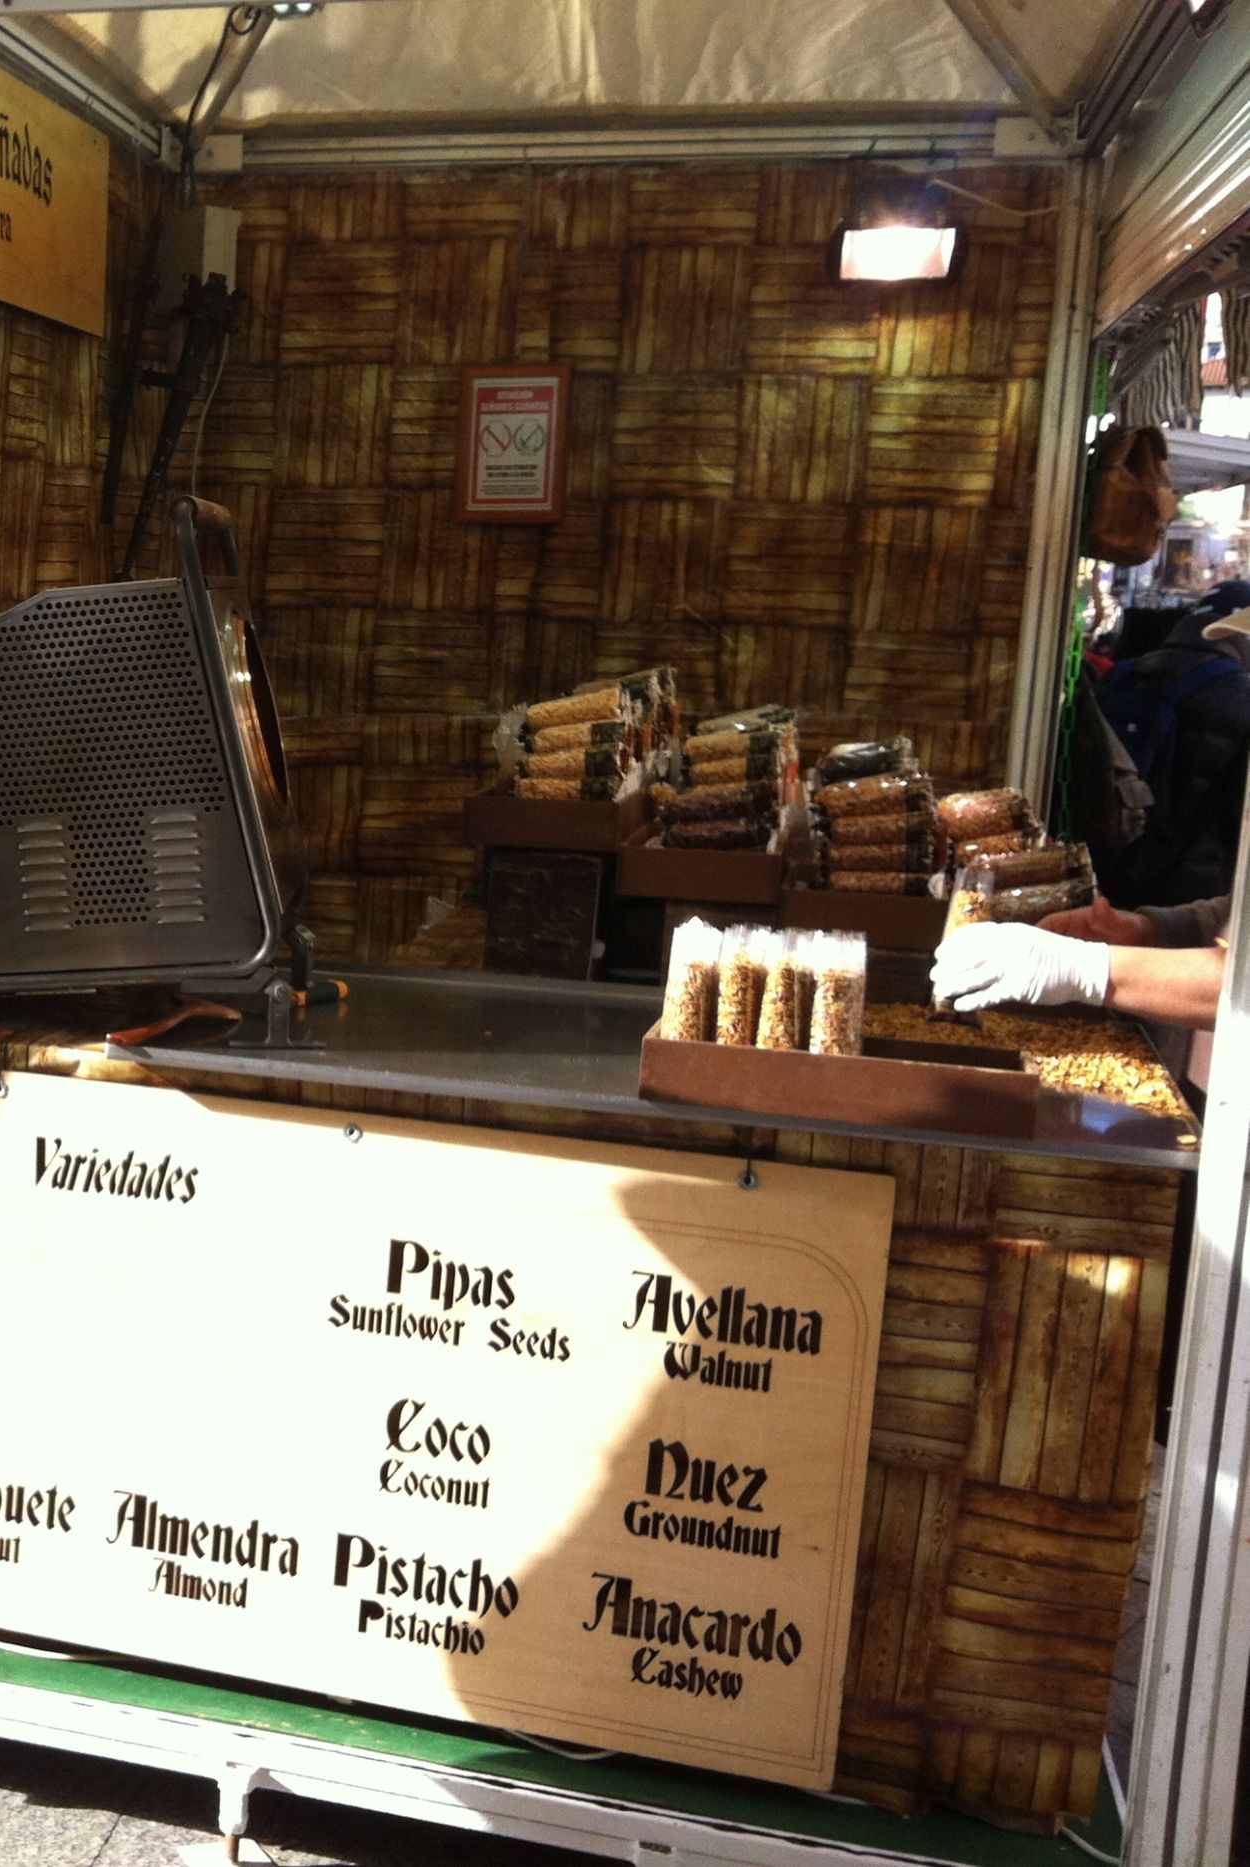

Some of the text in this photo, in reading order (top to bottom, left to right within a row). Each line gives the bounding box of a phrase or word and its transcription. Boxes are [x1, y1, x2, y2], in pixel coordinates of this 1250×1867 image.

[34, 1136, 199, 1204] Variedades
[386, 1239, 516, 1312] Pipas
[328, 1294, 572, 1363] Sunflower Seeds
[622, 1271, 824, 1357] Avellana
[663, 1341, 774, 1393] Walnut
[384, 1398, 492, 1466] Coco
[379, 1458, 491, 1510] Coconut
[644, 1437, 769, 1514] Nuez
[105, 1489, 300, 1578] Almendra
[623, 1500, 783, 1560] Groundnut
[147, 1557, 249, 1610] Almond
[332, 1531, 520, 1621] Pistacho
[357, 1597, 486, 1658] Pistachio
[582, 1571, 804, 1669] Anacardo
[630, 1646, 745, 1703] Cashew
